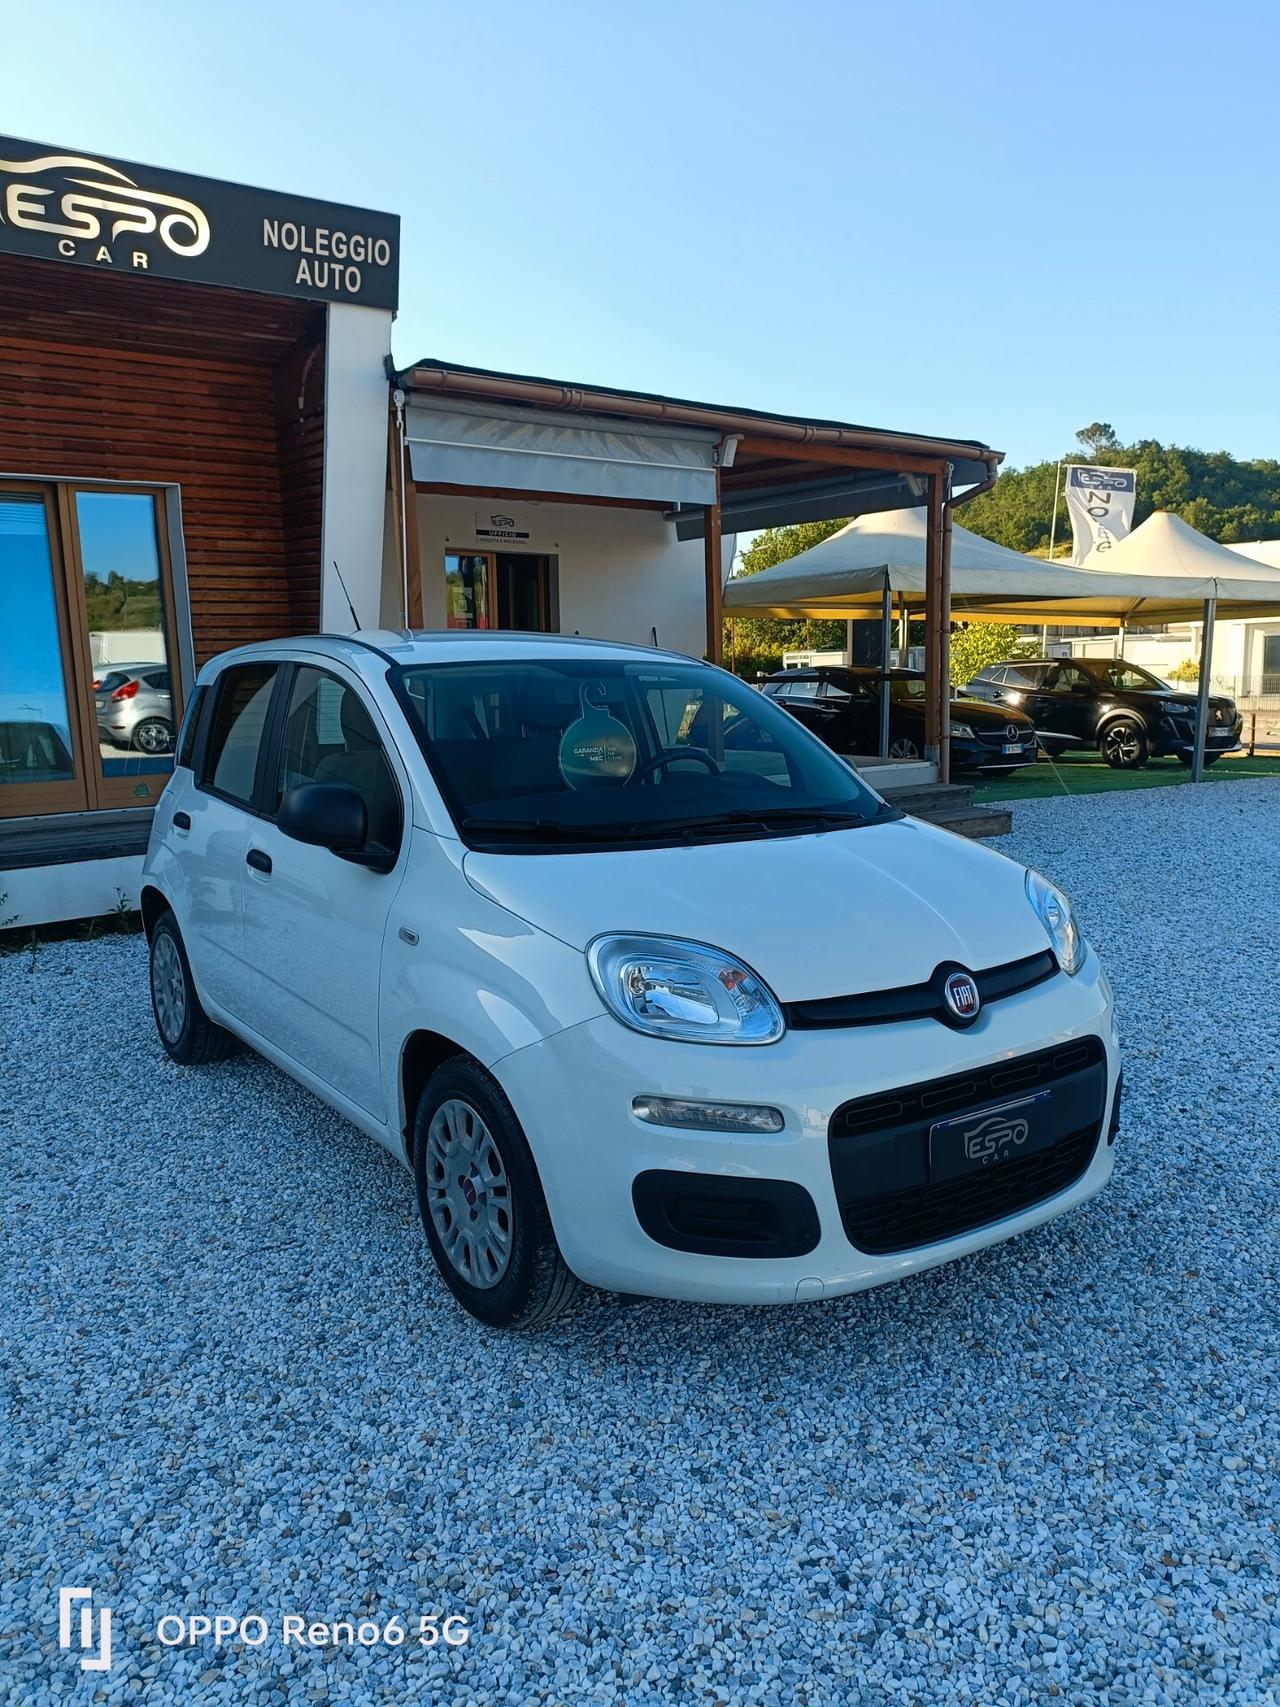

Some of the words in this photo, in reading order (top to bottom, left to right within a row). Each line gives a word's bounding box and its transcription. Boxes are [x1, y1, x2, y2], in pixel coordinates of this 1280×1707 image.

[6, 182, 211, 257] ESPO
[57, 239, 149, 269] CAR
[263, 218, 391, 267] NOLEGGIO
[295, 257, 362, 293] AUTO
[952, 984, 974, 1007] FIAT
[968, 1118, 1029, 1159] ESPO
[982, 1150, 1009, 1164] CAR
